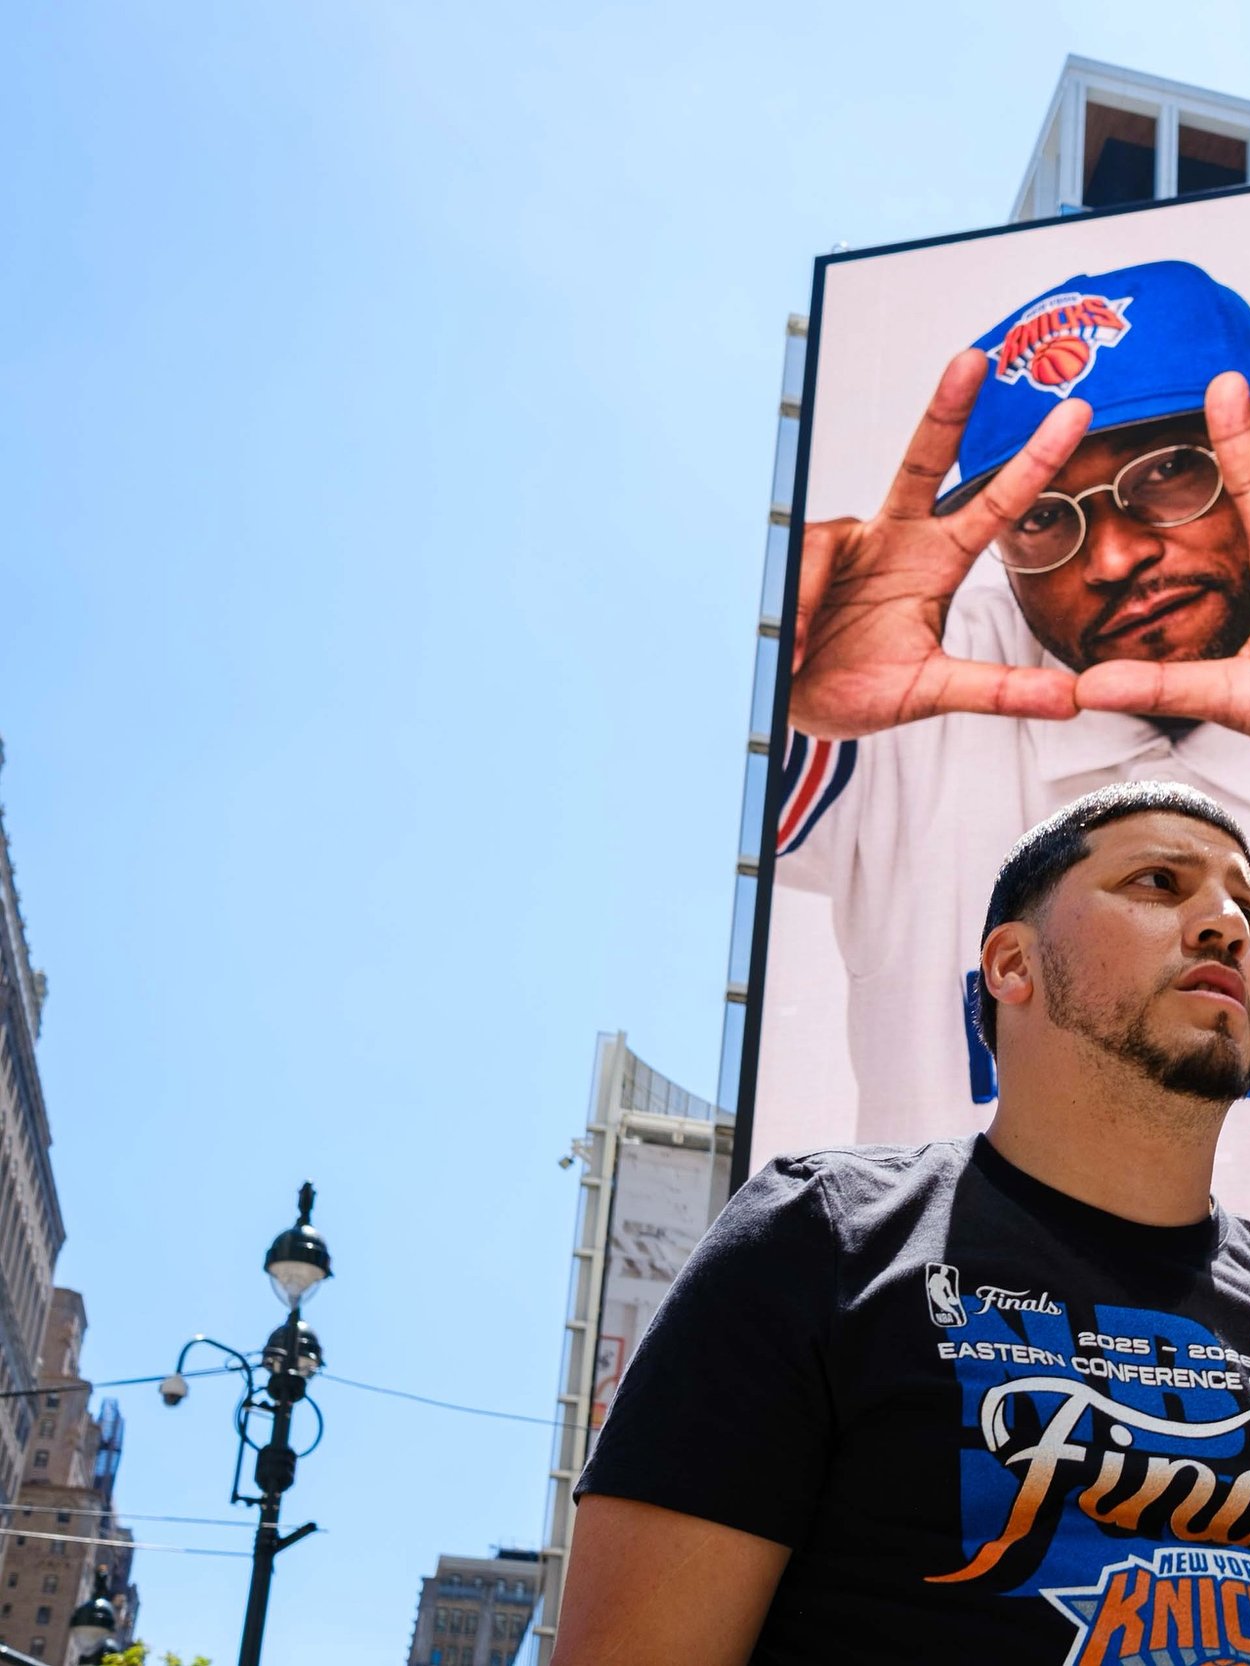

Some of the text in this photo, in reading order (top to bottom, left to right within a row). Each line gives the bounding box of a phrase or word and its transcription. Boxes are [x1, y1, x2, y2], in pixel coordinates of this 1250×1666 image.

[998, 298, 1124, 375] KNICKS
[973, 1285, 1062, 1316] Finals
[935, 1312, 954, 1324] NBA
[1078, 1331, 1150, 1355] 2025
[937, 1342, 1067, 1367] EASTERN
[1071, 1357, 1243, 1391] CONFERENCE
[1158, 1551, 1208, 1576] NEW
